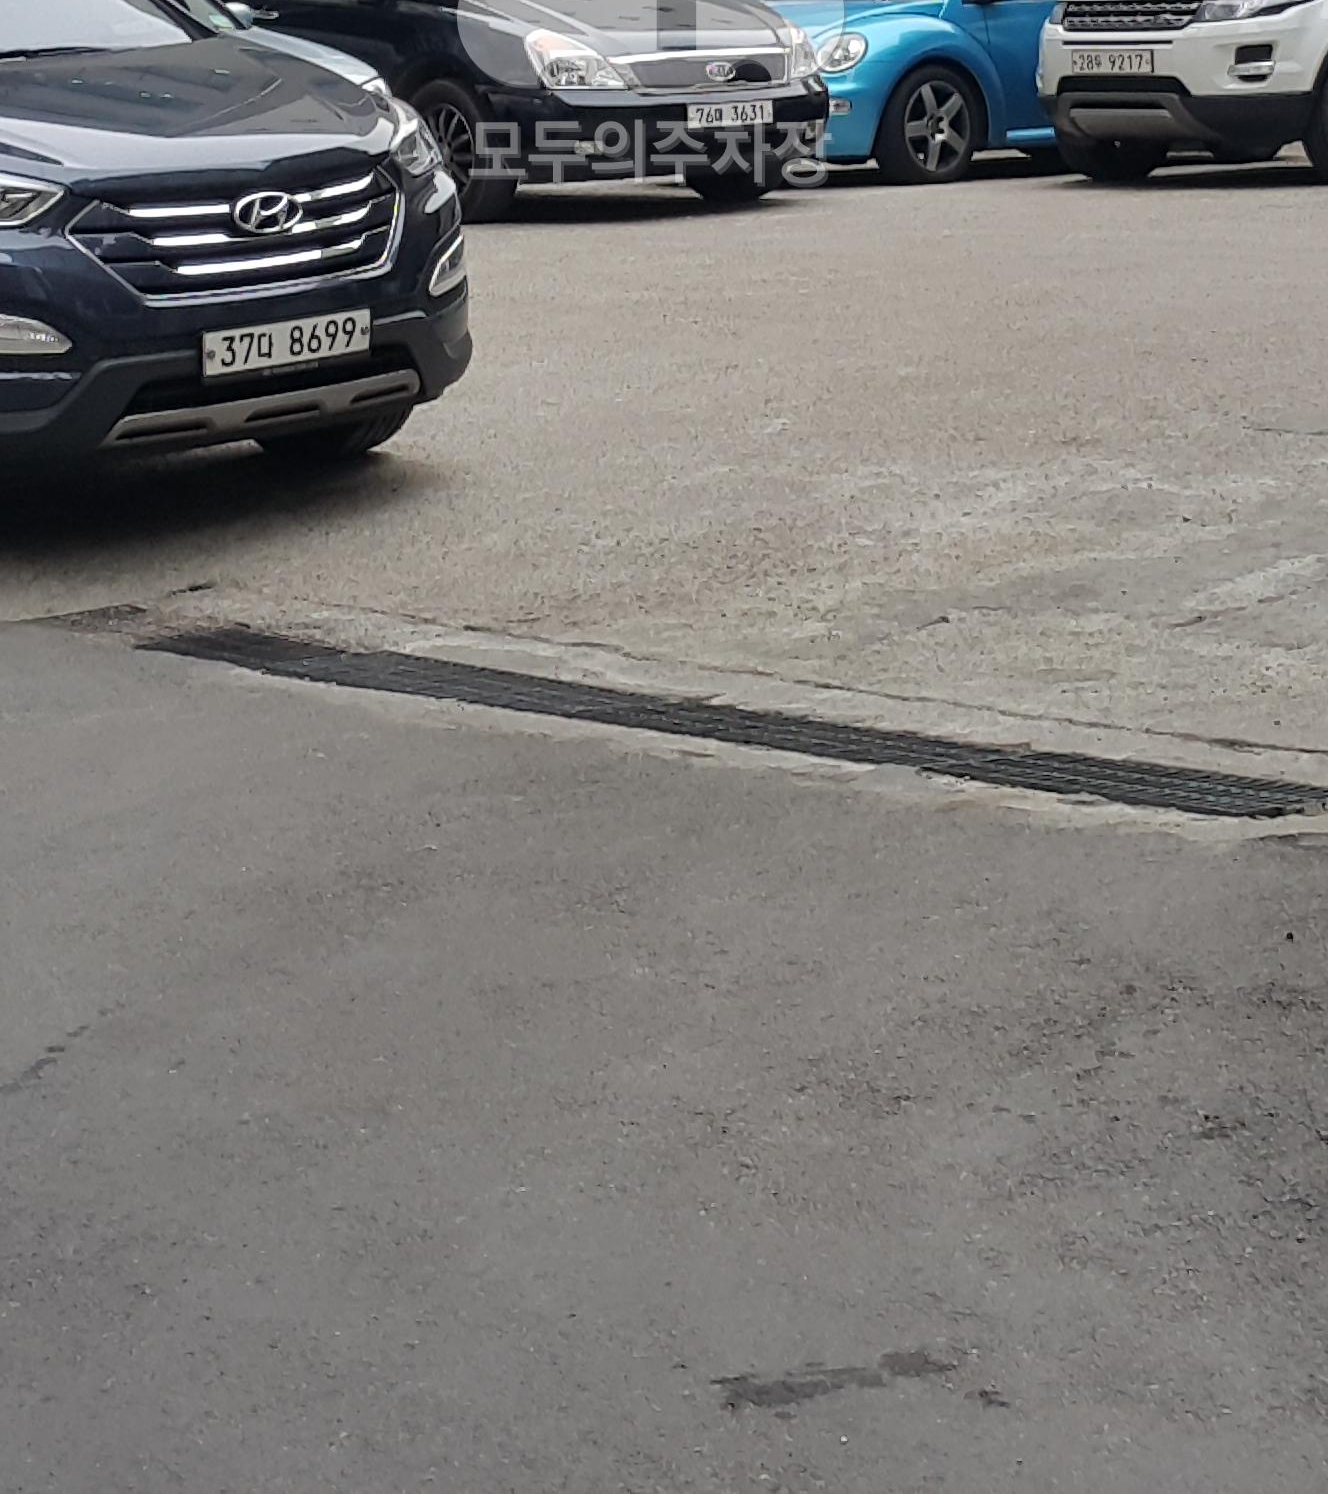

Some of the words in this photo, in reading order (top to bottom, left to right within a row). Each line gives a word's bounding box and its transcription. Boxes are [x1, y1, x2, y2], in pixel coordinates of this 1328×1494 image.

[1108, 54, 1143, 72] 9217
[731, 104, 765, 122] 3631
[289, 316, 357, 356] 8699
